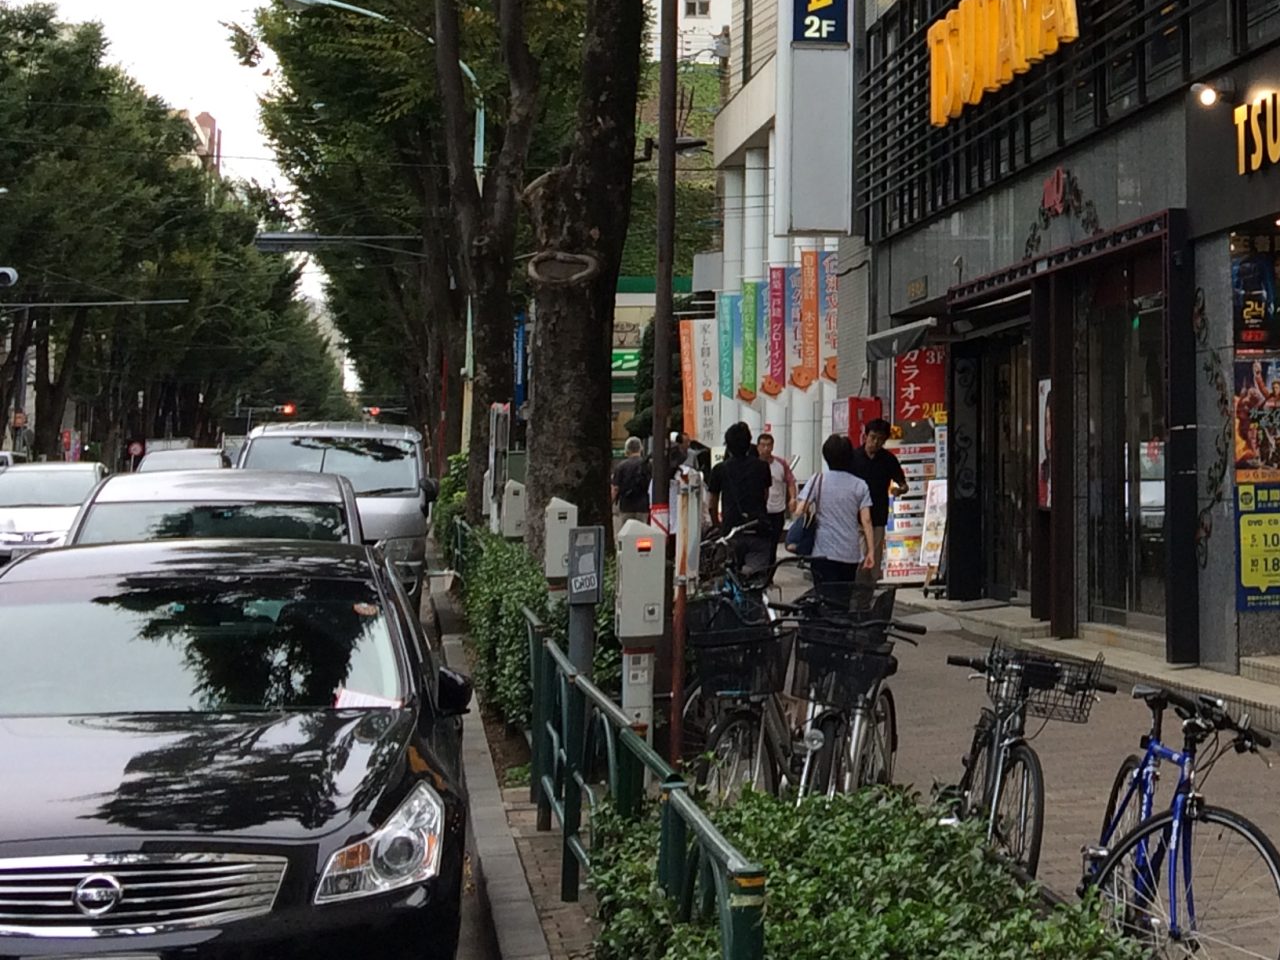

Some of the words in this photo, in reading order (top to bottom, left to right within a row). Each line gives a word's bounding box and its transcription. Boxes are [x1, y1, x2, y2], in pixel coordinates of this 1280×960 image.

[804, 16, 836, 38] 2F
[1242, 300, 1265, 319] 24
[900, 348, 920, 419] カラオケ
